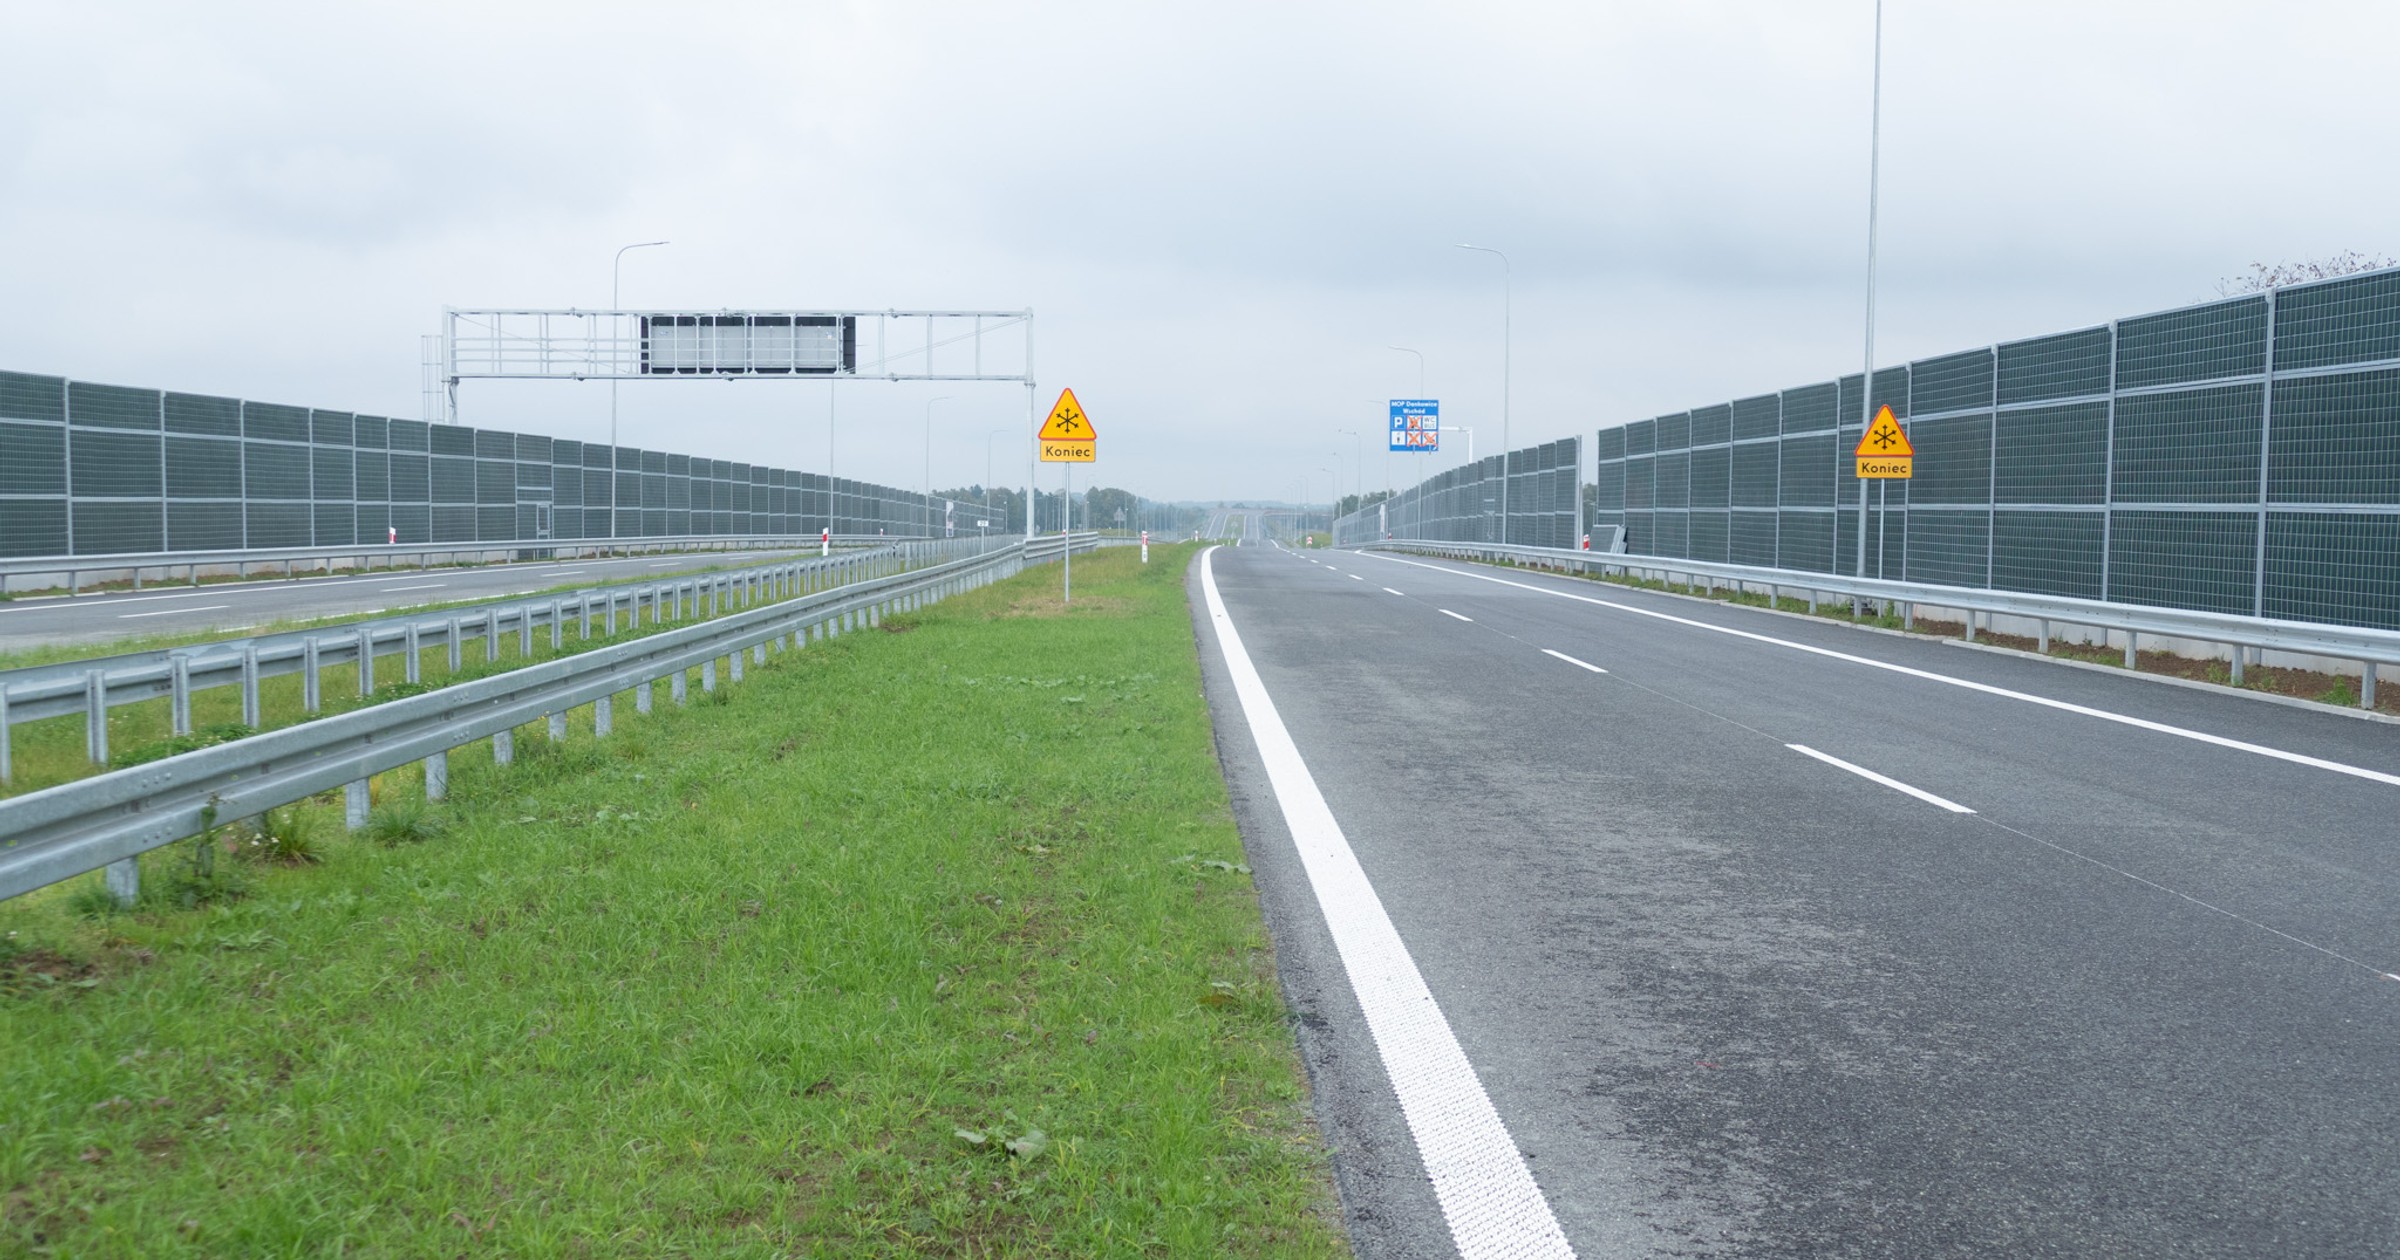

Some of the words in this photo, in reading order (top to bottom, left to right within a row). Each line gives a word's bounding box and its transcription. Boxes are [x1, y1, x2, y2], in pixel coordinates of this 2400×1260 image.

[1394, 416, 1403, 428] P
[1046, 446, 1090, 457] Koniec
[1862, 462, 1907, 473] Koniec
